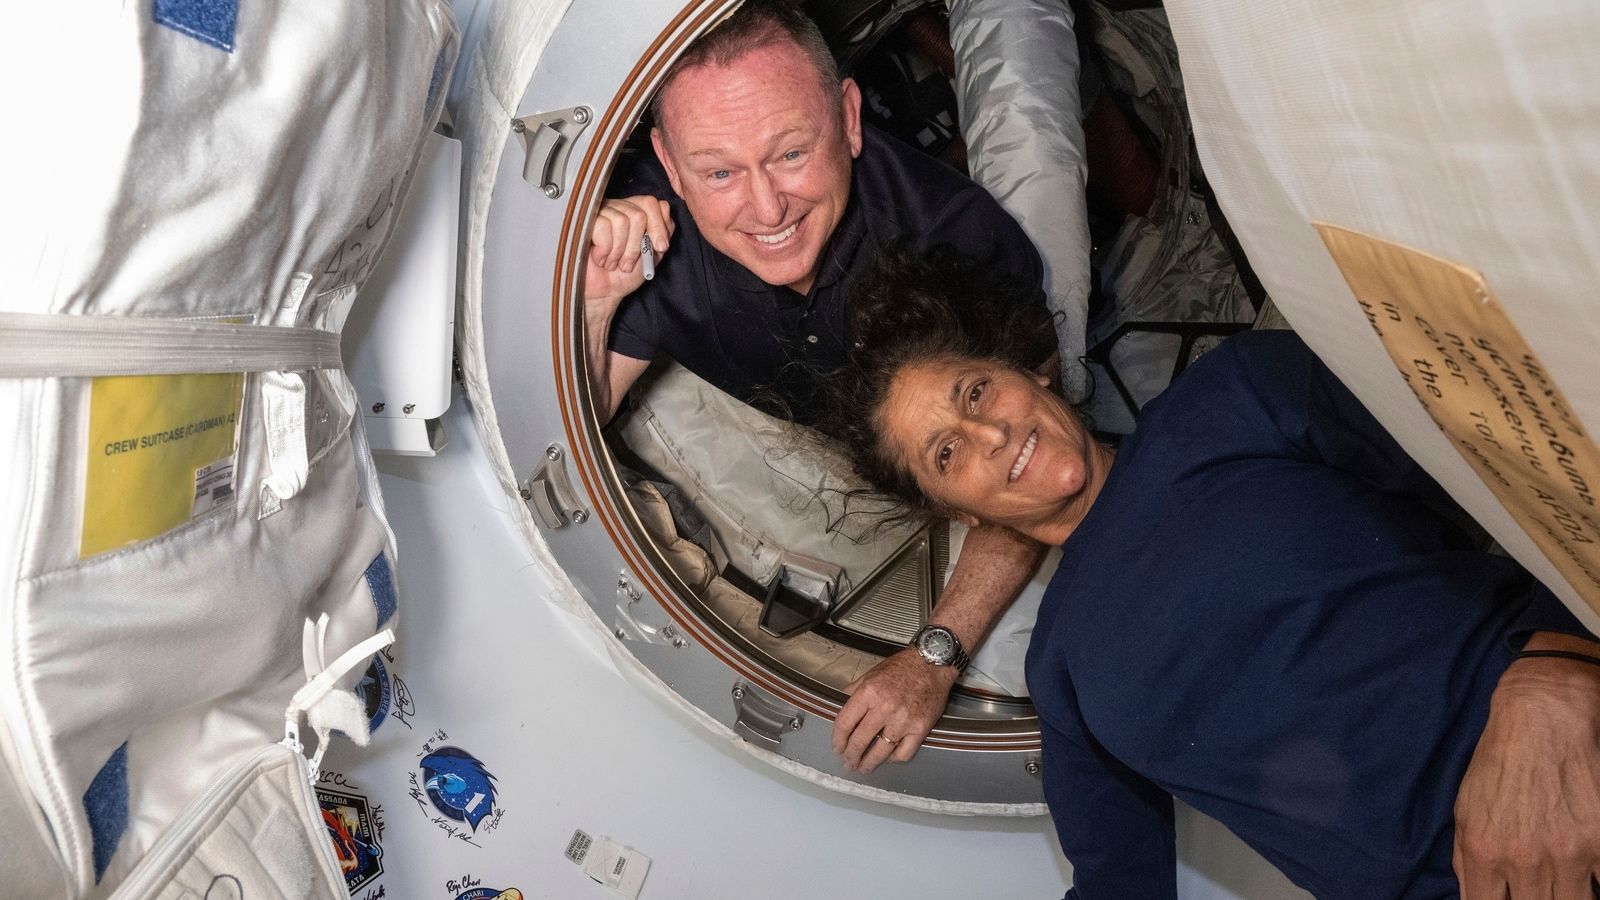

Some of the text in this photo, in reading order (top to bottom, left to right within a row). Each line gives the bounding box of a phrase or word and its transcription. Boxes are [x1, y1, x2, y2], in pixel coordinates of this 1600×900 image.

[1380, 301, 1401, 322] in
[1413, 358, 1443, 398] the
[1414, 316, 1468, 386] cover
[104, 438, 139, 456] CREW
[141, 427, 184, 448] SUITCASE
[1445, 331, 1549, 476] положении
[1470, 336, 1595, 507] установить
